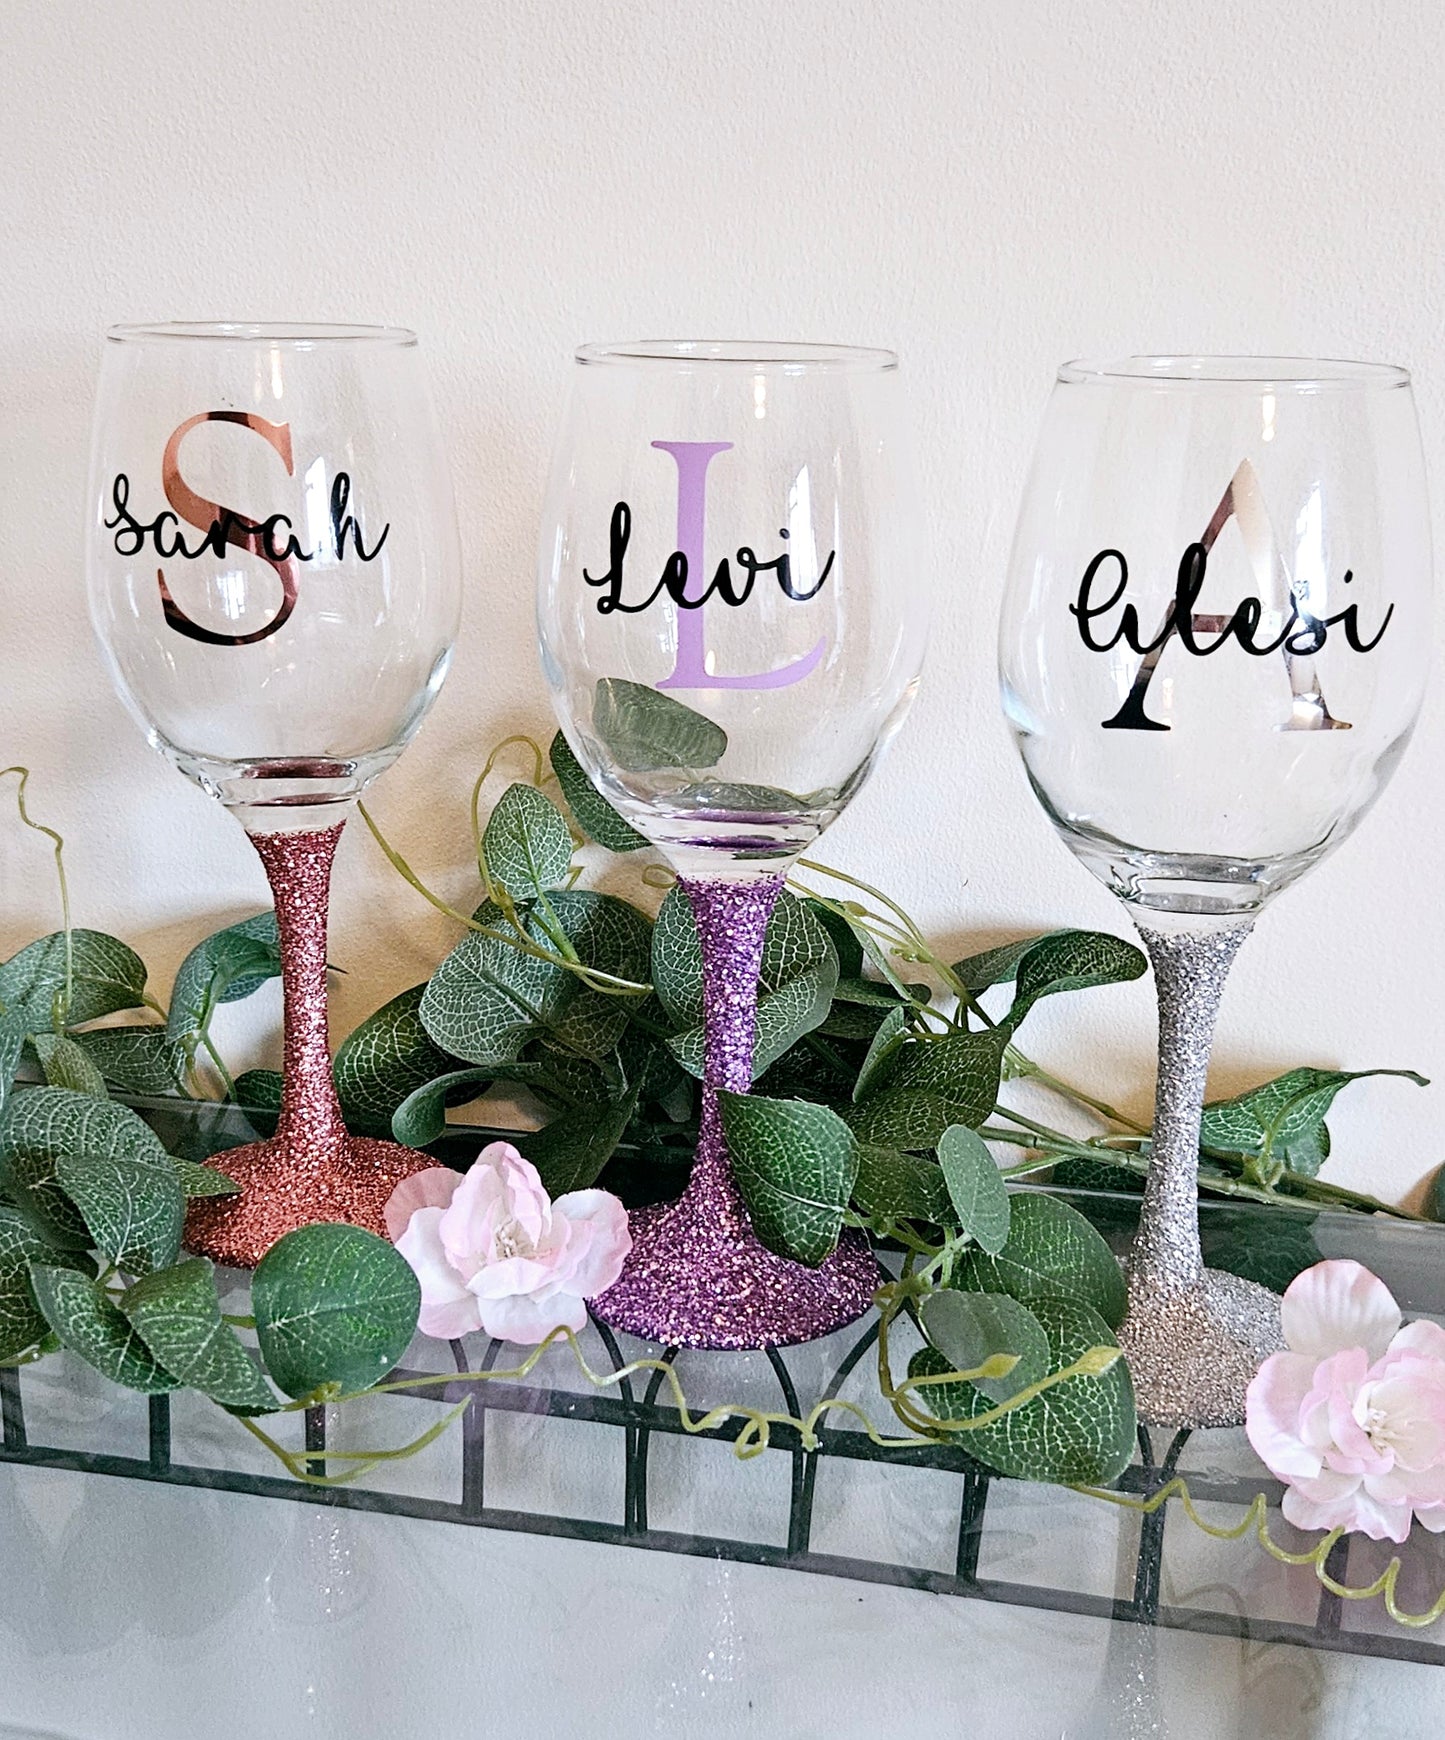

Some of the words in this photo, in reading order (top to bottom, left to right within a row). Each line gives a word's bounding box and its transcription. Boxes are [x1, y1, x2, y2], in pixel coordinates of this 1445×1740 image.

[157, 410, 301, 646] S
[583, 501, 836, 615] Levi
[650, 440, 828, 690] L
[1069, 542, 1395, 656] Alesi
[1100, 457, 1353, 732] A
